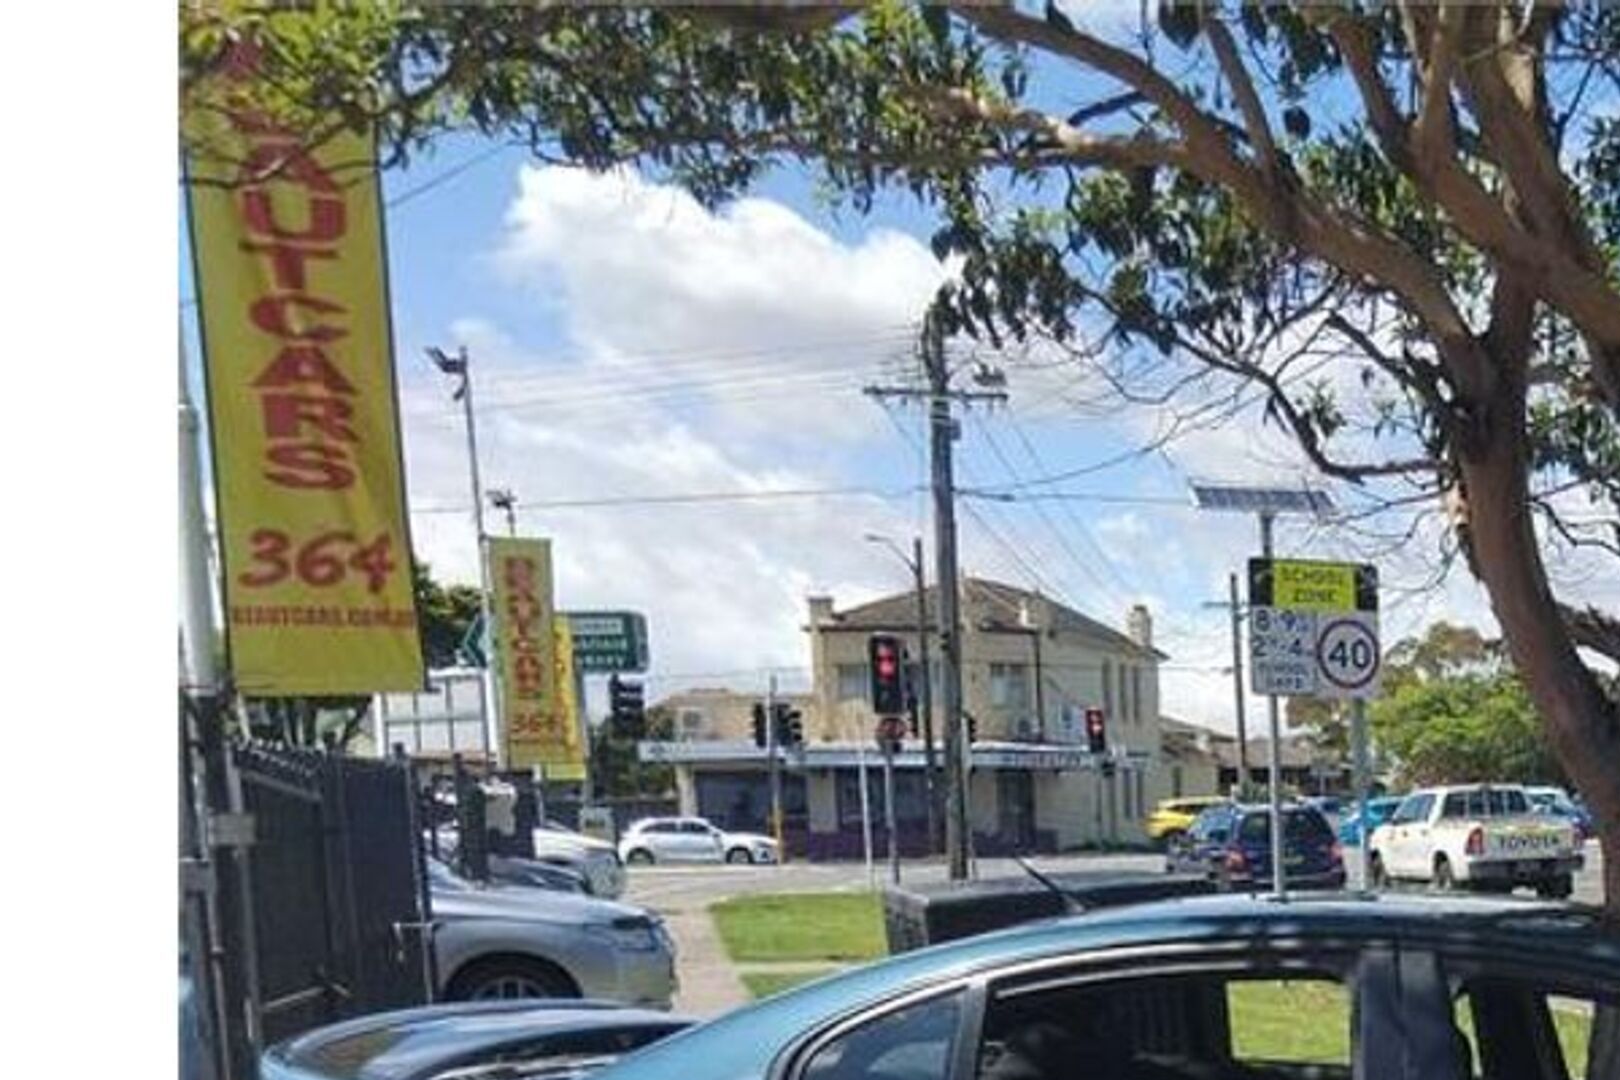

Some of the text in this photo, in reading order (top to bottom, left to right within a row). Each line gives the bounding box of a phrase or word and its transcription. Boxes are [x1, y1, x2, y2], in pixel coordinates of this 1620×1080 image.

[238, 528, 395, 593] 364
[1280, 566, 1346, 585] SCHOOL
[1293, 587, 1337, 603] ZONE
[1328, 638, 1372, 669] 40
[1499, 835, 1559, 849] TOYOTA
